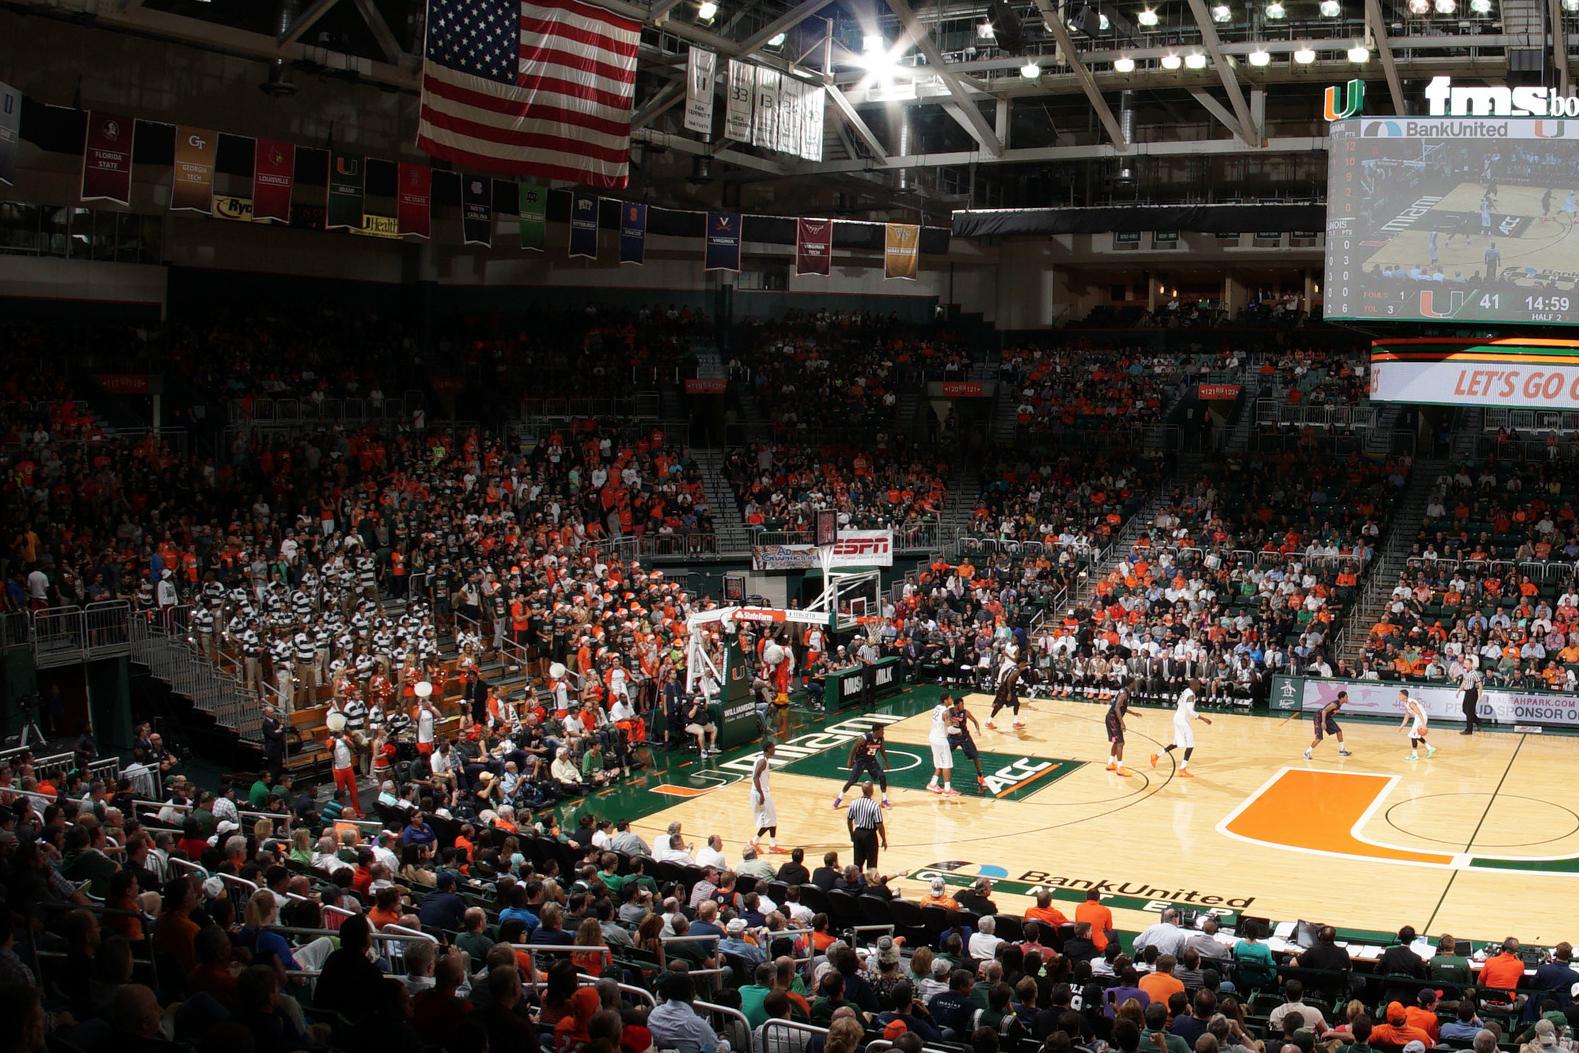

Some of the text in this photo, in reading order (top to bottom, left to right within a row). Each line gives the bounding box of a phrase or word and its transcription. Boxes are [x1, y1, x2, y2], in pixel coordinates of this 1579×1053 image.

[1324, 79, 1365, 122] U
[1425, 76, 1548, 116] fms
[1406, 121, 1508, 137] BankUnited
[95, 151, 123, 162] FLORIDA
[98, 160, 119, 170] STATE
[1344, 240, 1350, 249] 0
[1343, 255, 1349, 265] 3
[1343, 271, 1349, 280] 0
[1342, 287, 1348, 297] 0
[1399, 291, 1405, 300] 1
[1342, 303, 1348, 313] 6
[1480, 293, 1500, 309] 41
[1525, 296, 1570, 311] 14:59
[1387, 305, 1394, 314] 3
[1531, 313, 1562, 321] HALF 2
[1454, 369, 1520, 398] LET'S
[1522, 372, 1564, 398] GO
[833, 537, 889, 555] ESPN
[875, 666, 894, 686] MILK
[1497, 705, 1564, 720] SPONSOR
[984, 757, 1053, 795] ACC
[1017, 870, 1256, 908] BankUnited
